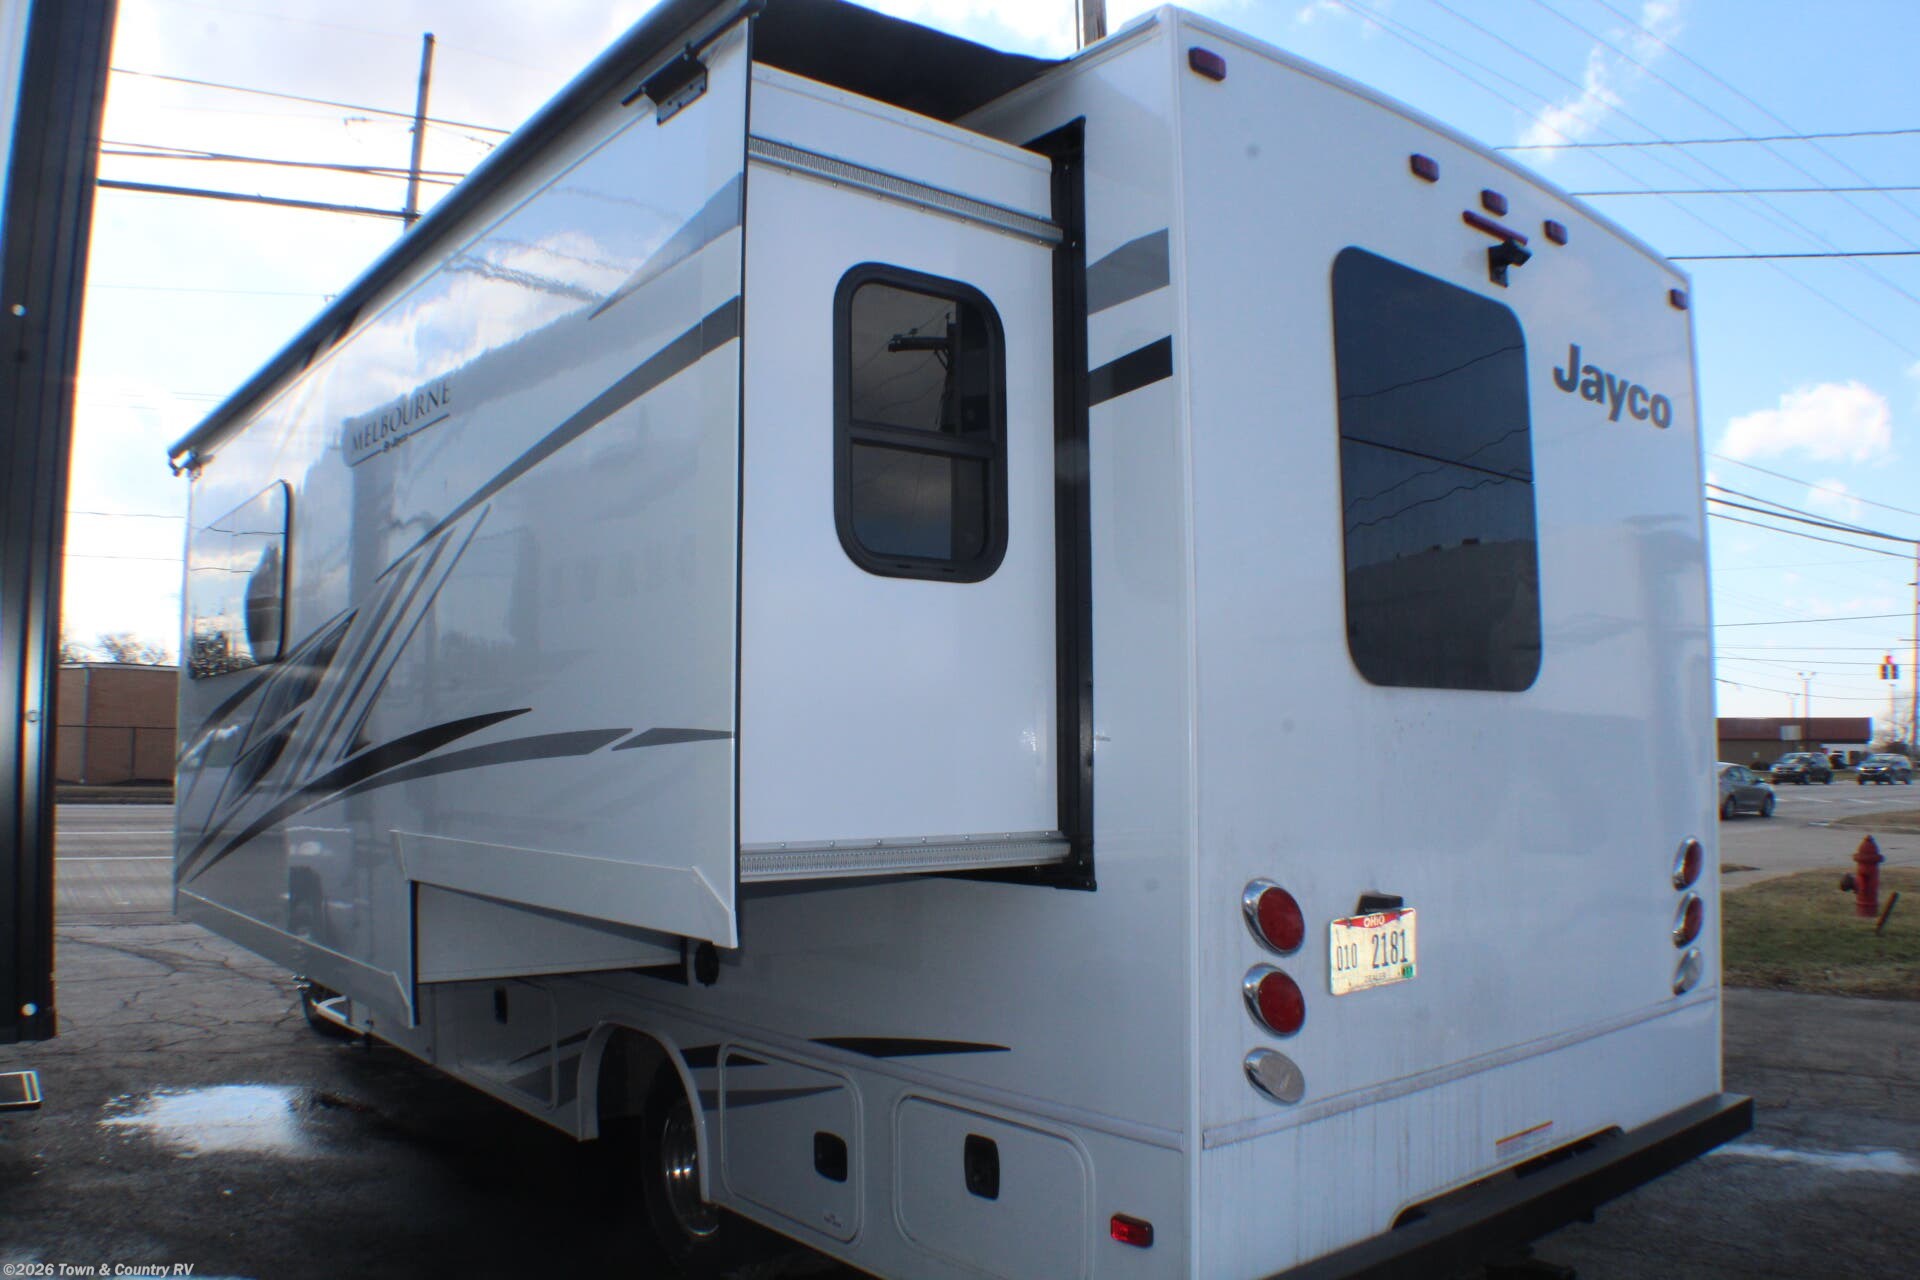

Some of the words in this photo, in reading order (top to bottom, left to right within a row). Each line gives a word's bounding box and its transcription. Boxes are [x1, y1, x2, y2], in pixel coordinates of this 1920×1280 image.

[352, 379, 451, 450] MELBOURNE
[1552, 343, 1672, 429] Jayco
[1336, 943, 1358, 971] 010
[1371, 929, 1408, 969] 2181
